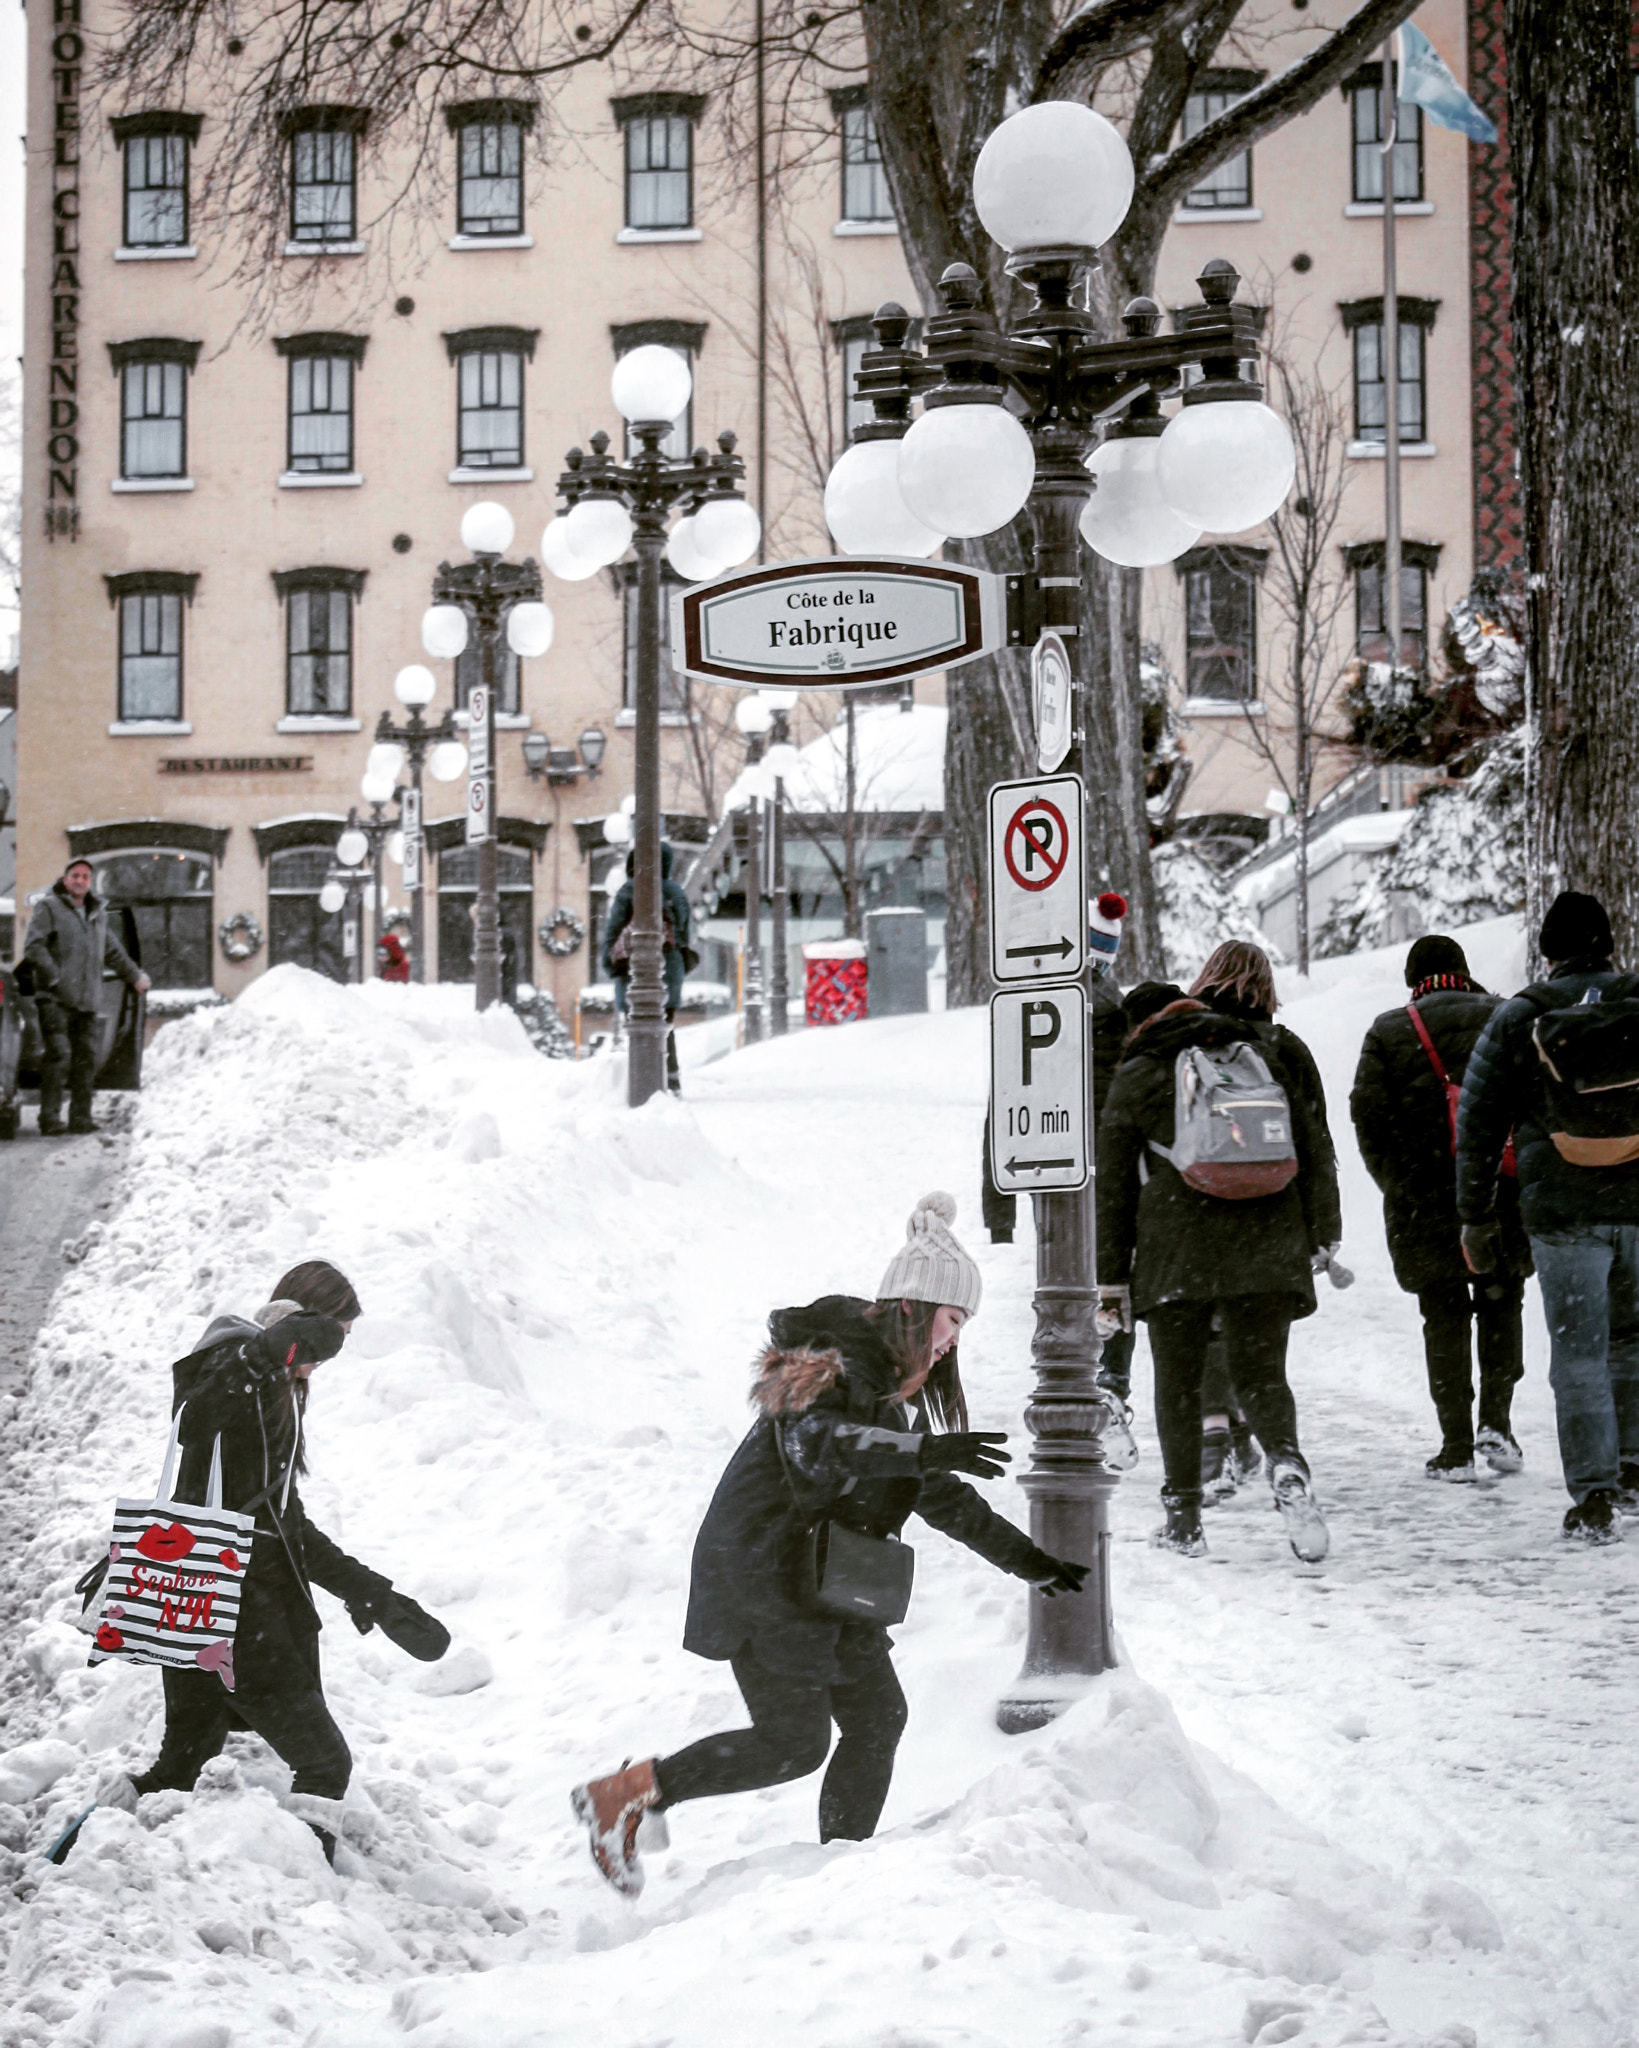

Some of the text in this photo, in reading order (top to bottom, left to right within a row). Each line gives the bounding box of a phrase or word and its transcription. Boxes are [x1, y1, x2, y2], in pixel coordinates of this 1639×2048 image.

[48, 0, 83, 499] HOTEL CLARENDON
[786, 589, 875, 610] Côte de la
[768, 616, 898, 649] Fabrique
[165, 756, 306, 772] RESTAURANT
[1021, 1001, 1062, 1086] P
[1008, 1103, 1069, 1137] 10 min
[125, 1565, 218, 1602] Sephora
[157, 1592, 219, 1632] NYC
